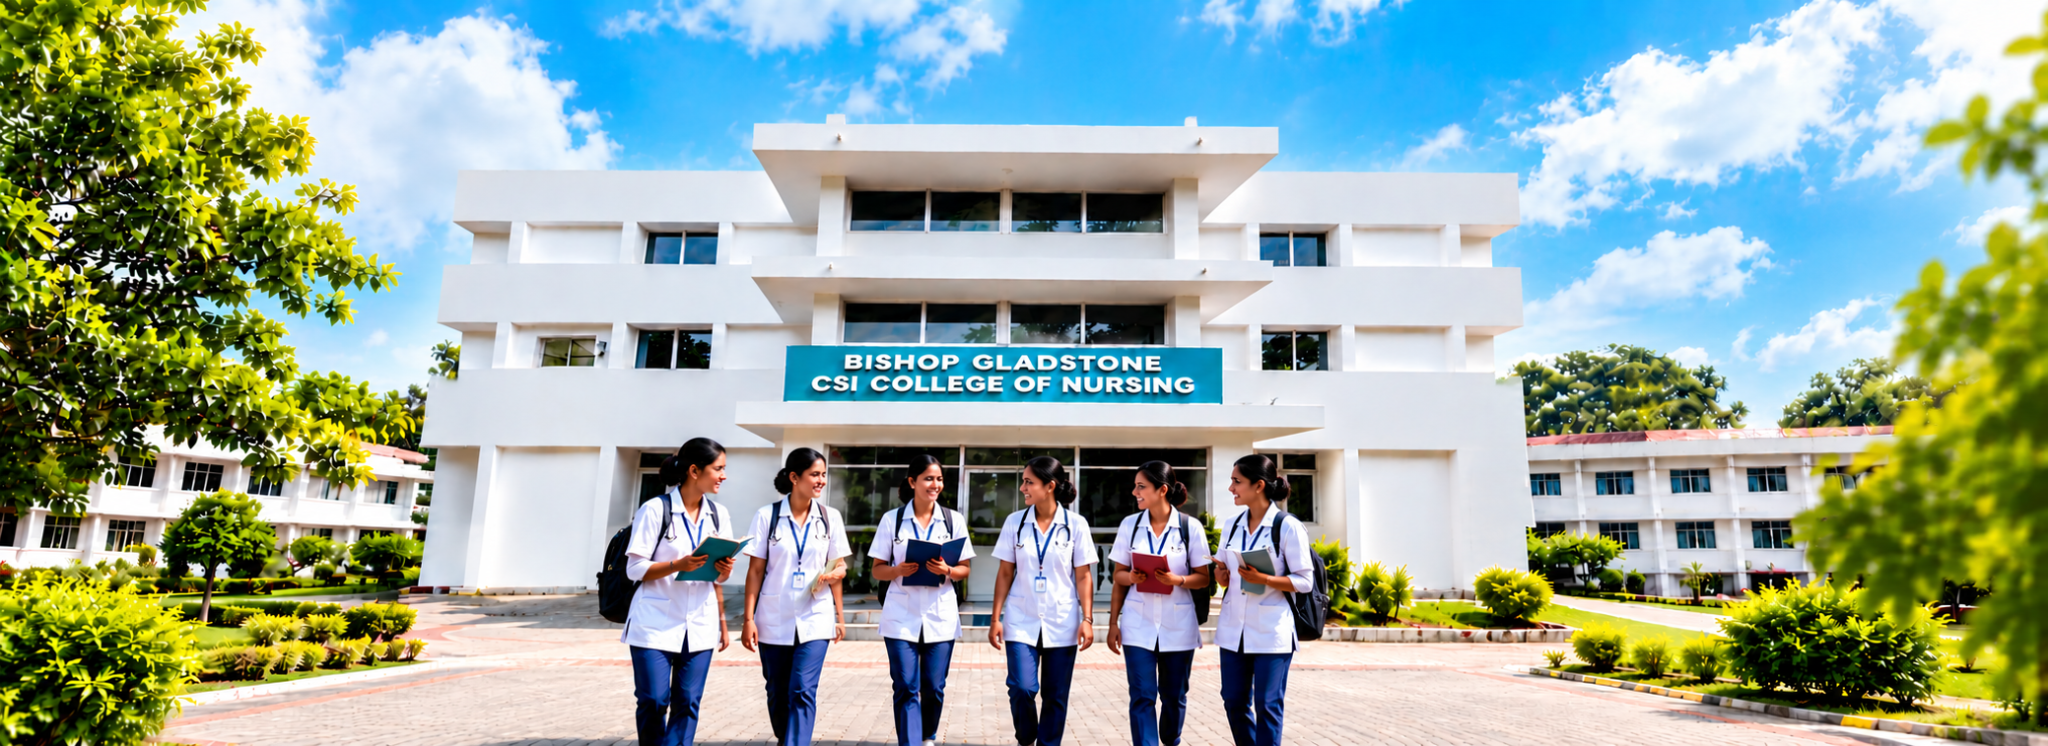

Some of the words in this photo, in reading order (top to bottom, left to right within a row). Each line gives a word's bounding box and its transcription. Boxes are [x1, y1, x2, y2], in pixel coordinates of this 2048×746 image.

[844, 353, 960, 371] BISHOP
[972, 353, 1162, 372] GLADSTONE
[811, 375, 858, 392] CSI
[870, 374, 1004, 393] COLLEGE
[1013, 375, 1052, 393] OF
[1062, 376, 1195, 394] NURSING
